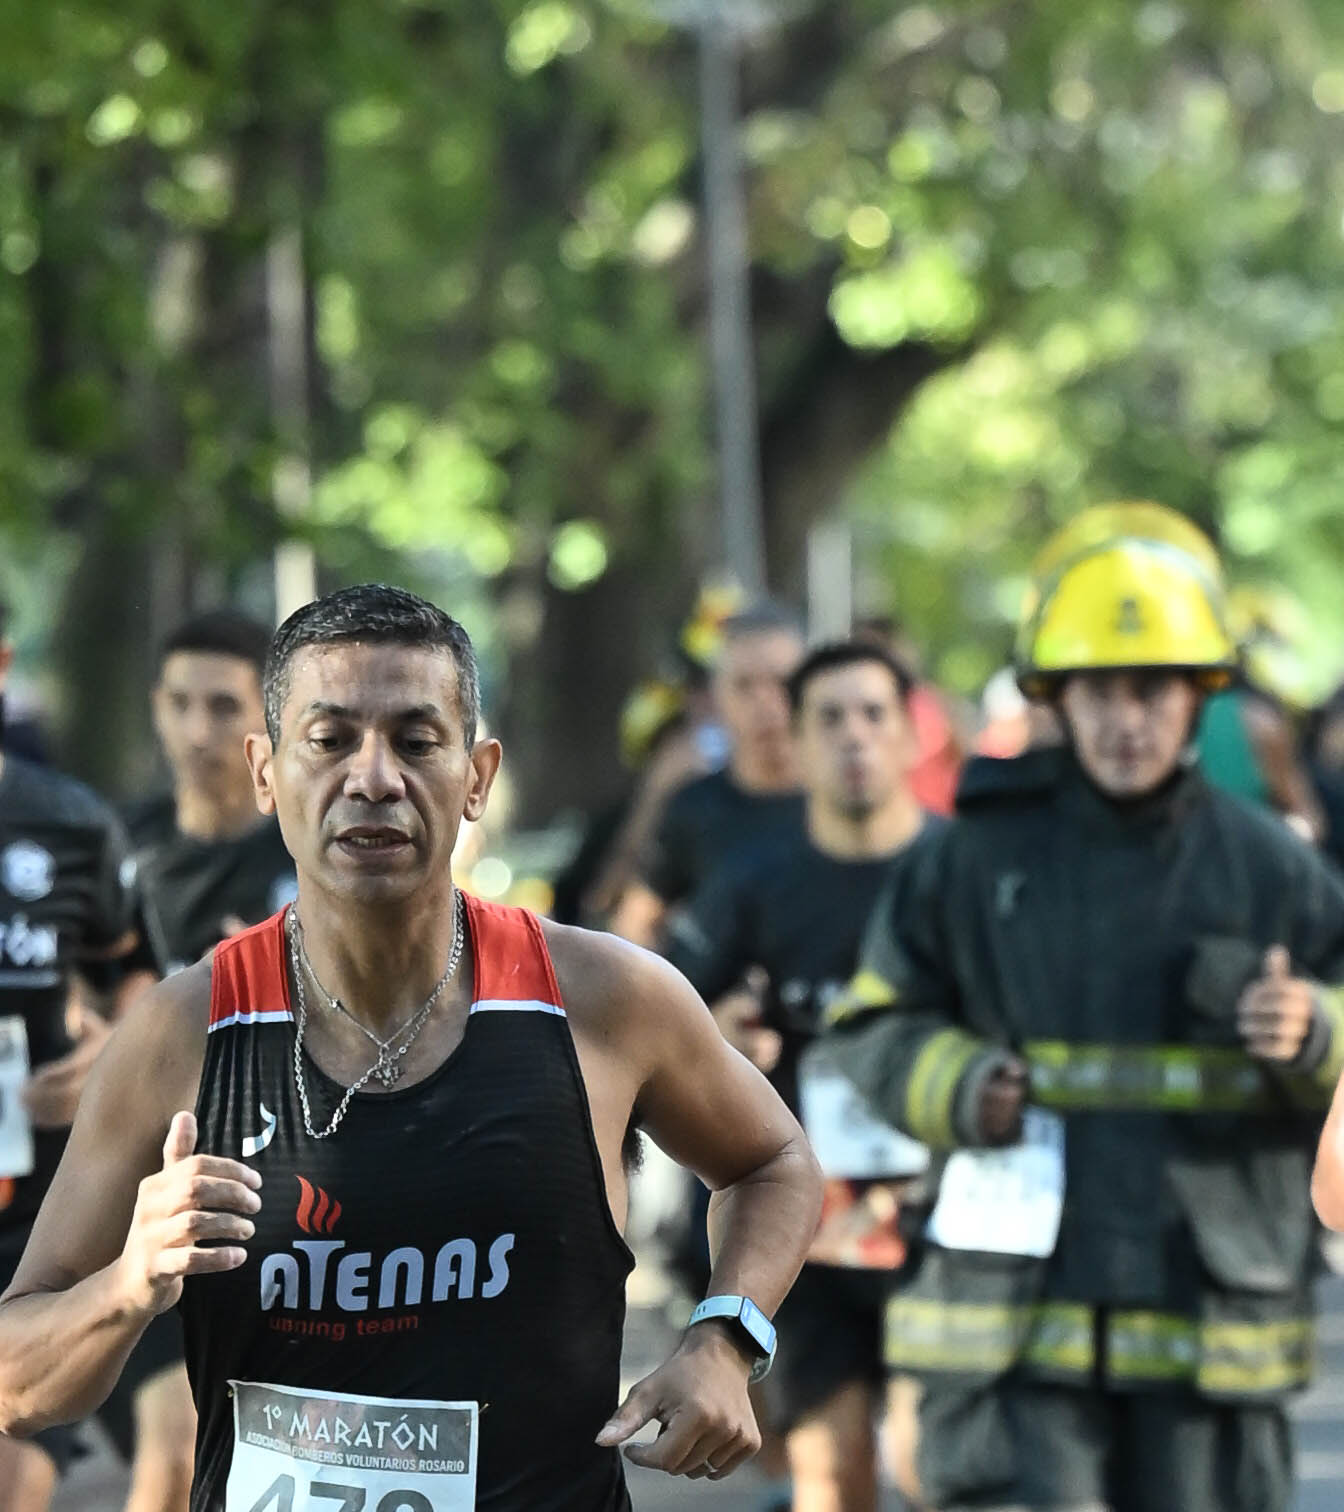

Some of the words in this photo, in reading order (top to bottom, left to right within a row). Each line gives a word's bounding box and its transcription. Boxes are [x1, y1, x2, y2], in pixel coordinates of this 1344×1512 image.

[260, 1232, 516, 1312] ATENAS
[356, 1314, 419, 1336] team
[289, 1413, 439, 1452] MARATÓN
[292, 1445, 345, 1465] BOMBEROS
[345, 1453, 417, 1471] VOLUNTARIOS
[418, 1459, 465, 1473] ROSARIO
